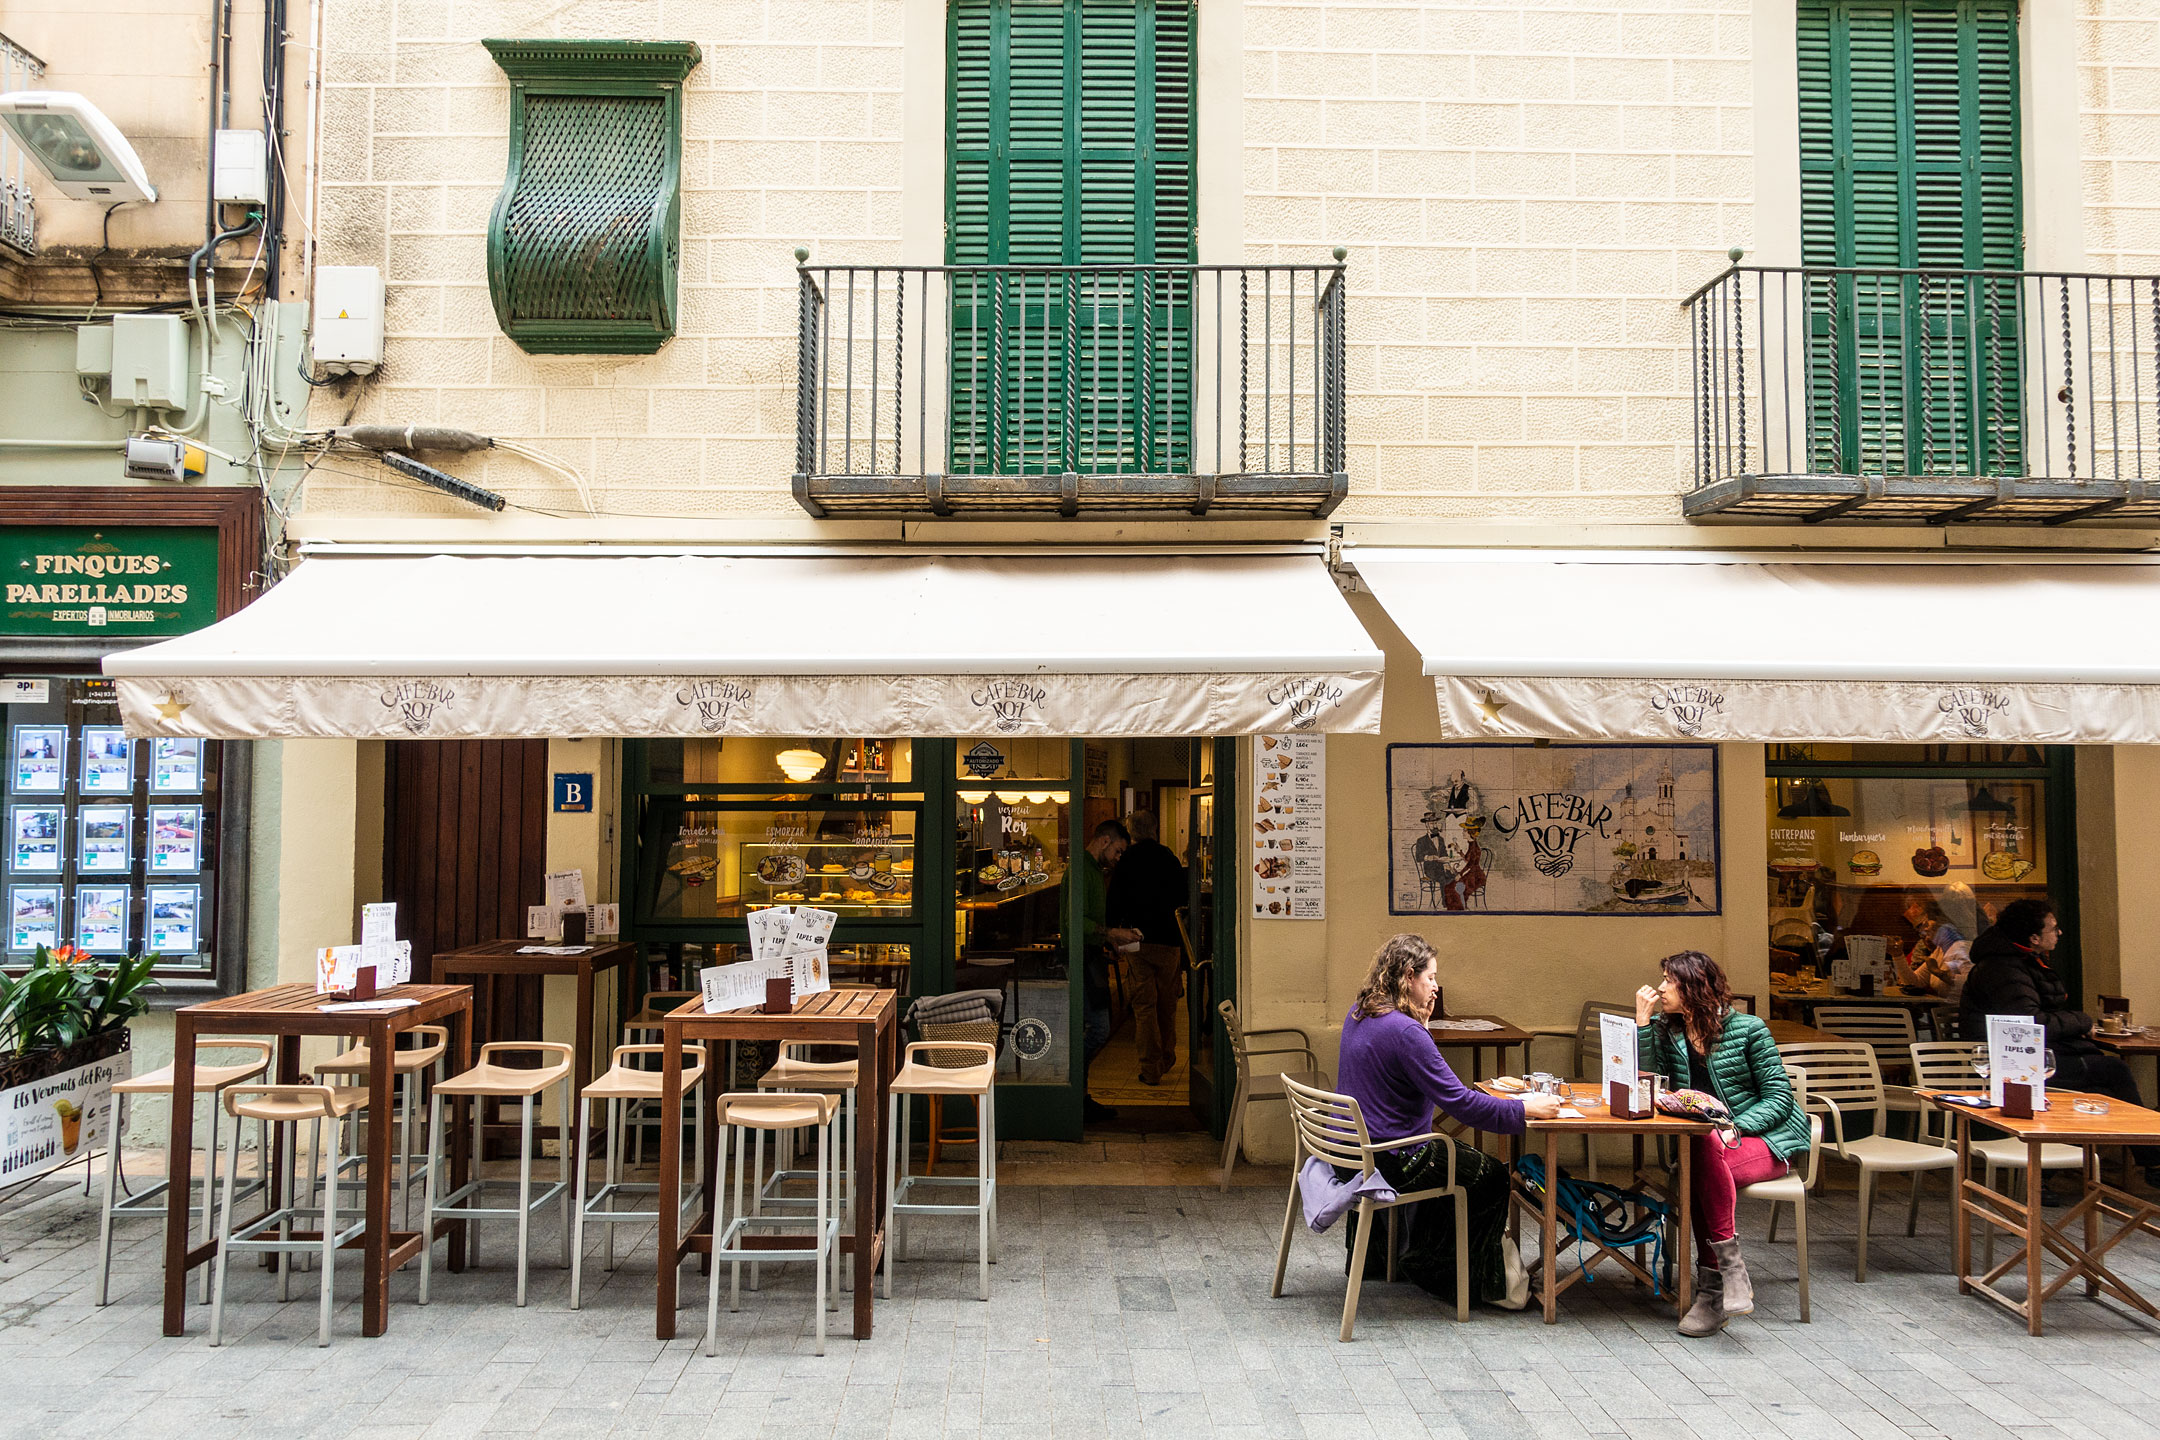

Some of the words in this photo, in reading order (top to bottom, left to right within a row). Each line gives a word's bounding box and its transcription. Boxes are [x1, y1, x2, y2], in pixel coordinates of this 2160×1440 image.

[35, 555, 160, 578] FINQUES
[5, 584, 188, 604] PARELLADES
[52, 610, 88, 621] EXPERTOS
[107, 610, 155, 621] INMOBILIARIOS
[401, 701, 440, 722] ROY
[697, 700, 737, 720] ROY
[992, 700, 1032, 721] ROY
[1289, 698, 1328, 718] ROY
[1672, 704, 1711, 725] ROY
[1958, 706, 1996, 727] ROY
[565, 783, 582, 803] B
[998, 805, 1032, 816] vermut
[766, 827, 804, 838] ESMORZAR
[1001, 816, 1028, 836] Roy
[1770, 828, 1816, 840] ENTREPANS
[1525, 824, 1591, 858] ROY
[1840, 831, 1886, 844] Hamburguesa
[14, 1091, 30, 1110] Els
[32, 1078, 76, 1104] Vermuts
[78, 1070, 94, 1086] del
[95, 1066, 112, 1084] Roy
